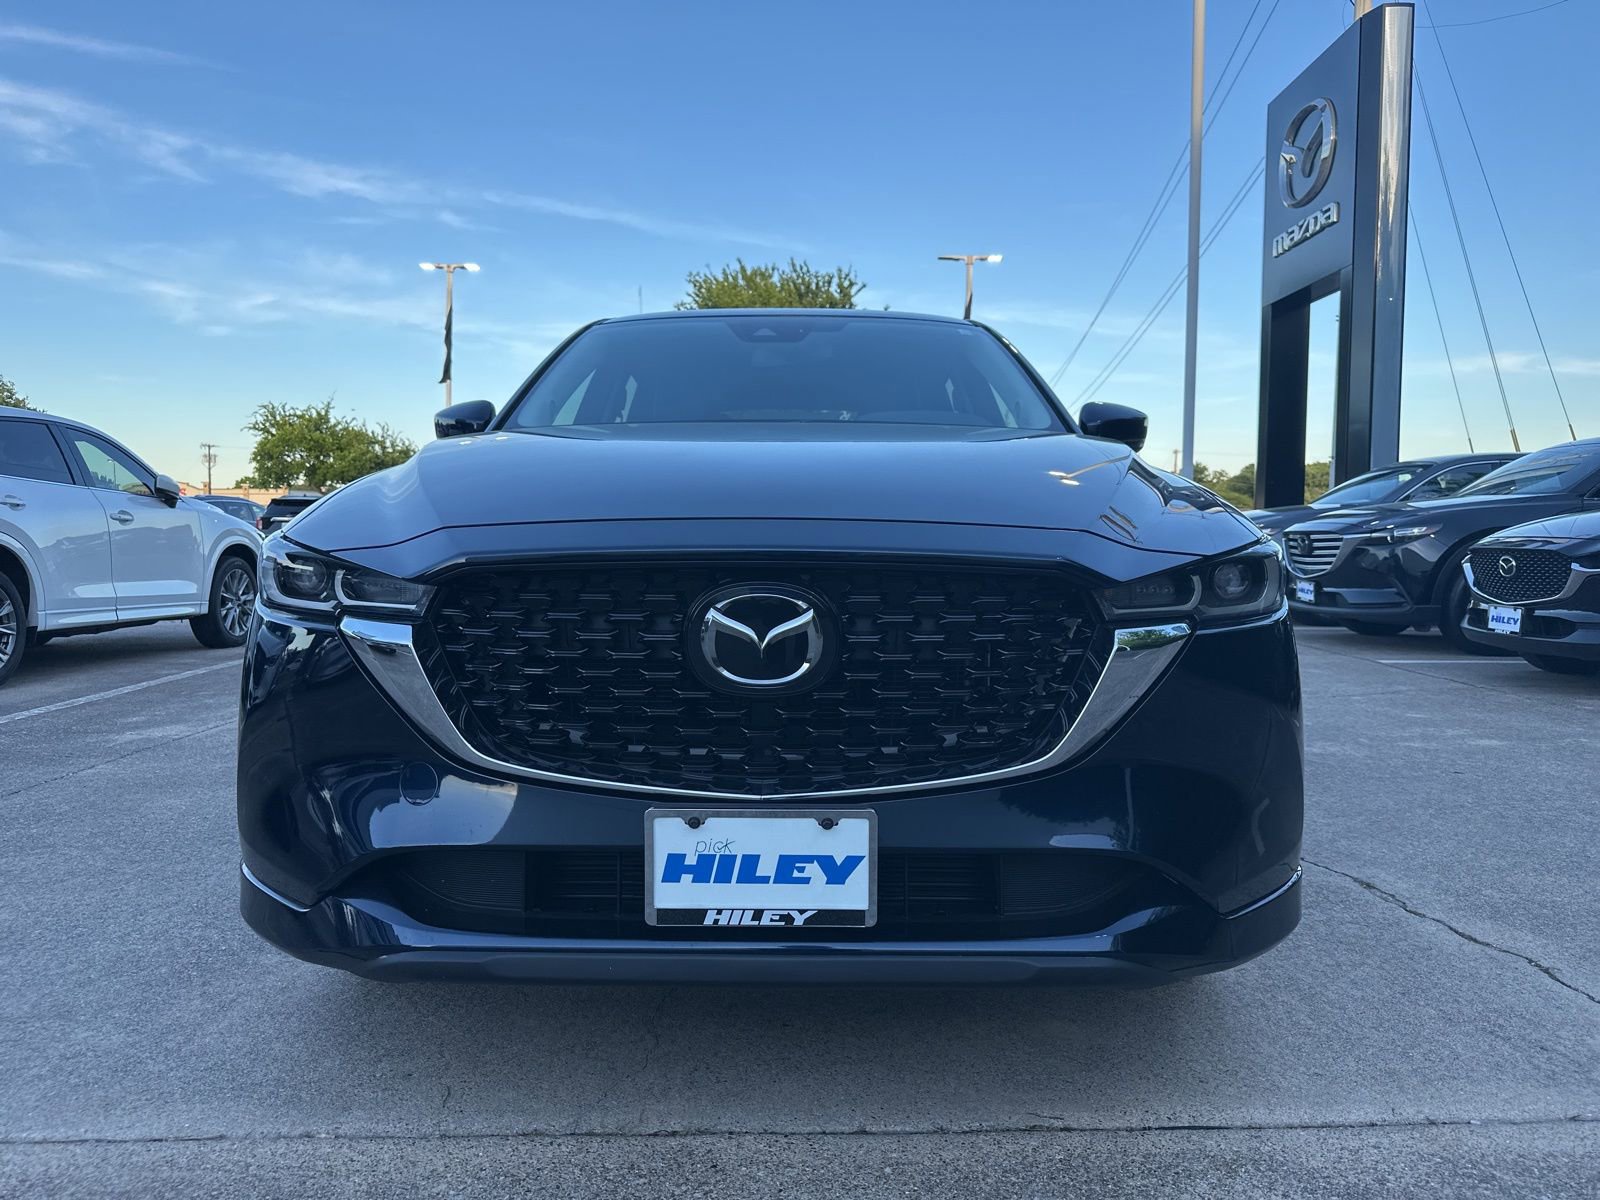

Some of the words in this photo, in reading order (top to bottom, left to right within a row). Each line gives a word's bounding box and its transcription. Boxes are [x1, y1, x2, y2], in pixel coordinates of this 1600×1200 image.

[1490, 614, 1520, 626] HILEY
[694, 838, 736, 856] pick
[661, 853, 866, 885] HILEY
[703, 910, 818, 926] HILEY
